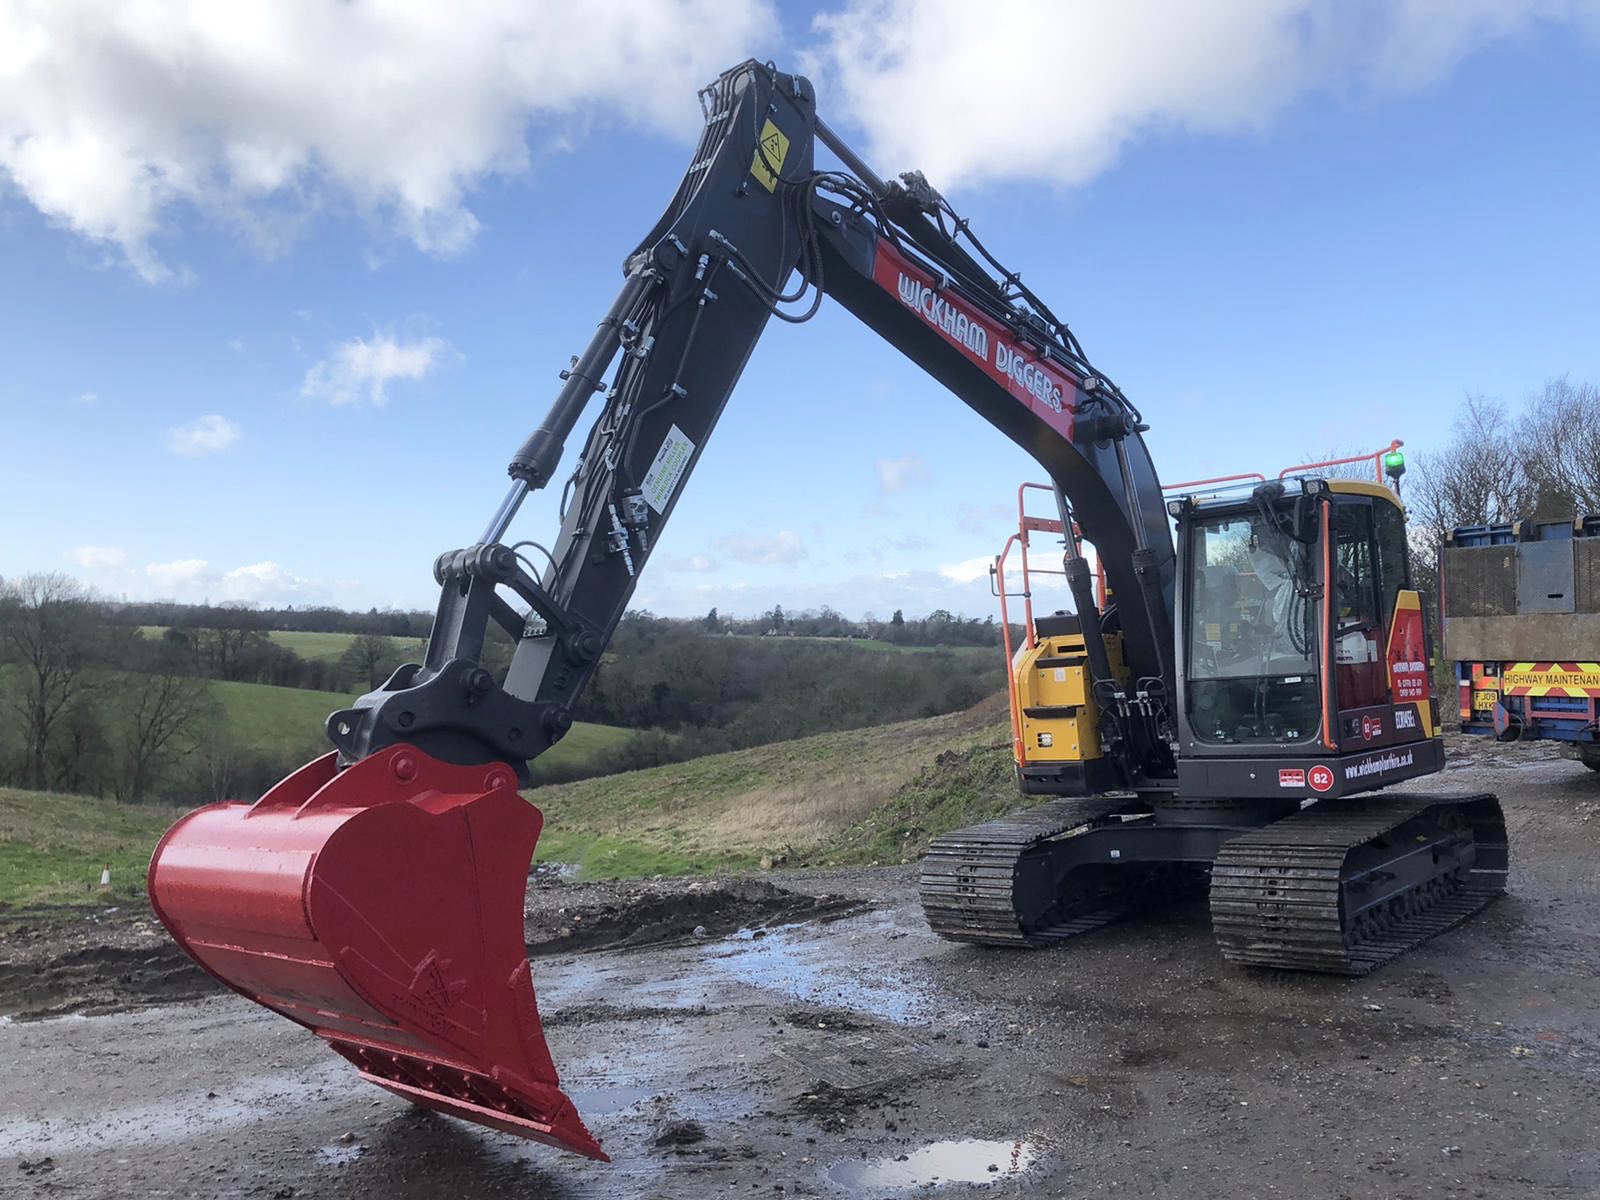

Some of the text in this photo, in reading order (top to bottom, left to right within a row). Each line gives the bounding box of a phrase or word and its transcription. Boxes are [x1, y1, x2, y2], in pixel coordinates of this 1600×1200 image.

[898, 272, 1063, 414] WICKHAM DIGGERS
[1504, 674, 1599, 686] HIGHWAY MAINTENAN
[1313, 772, 1328, 784] 82
